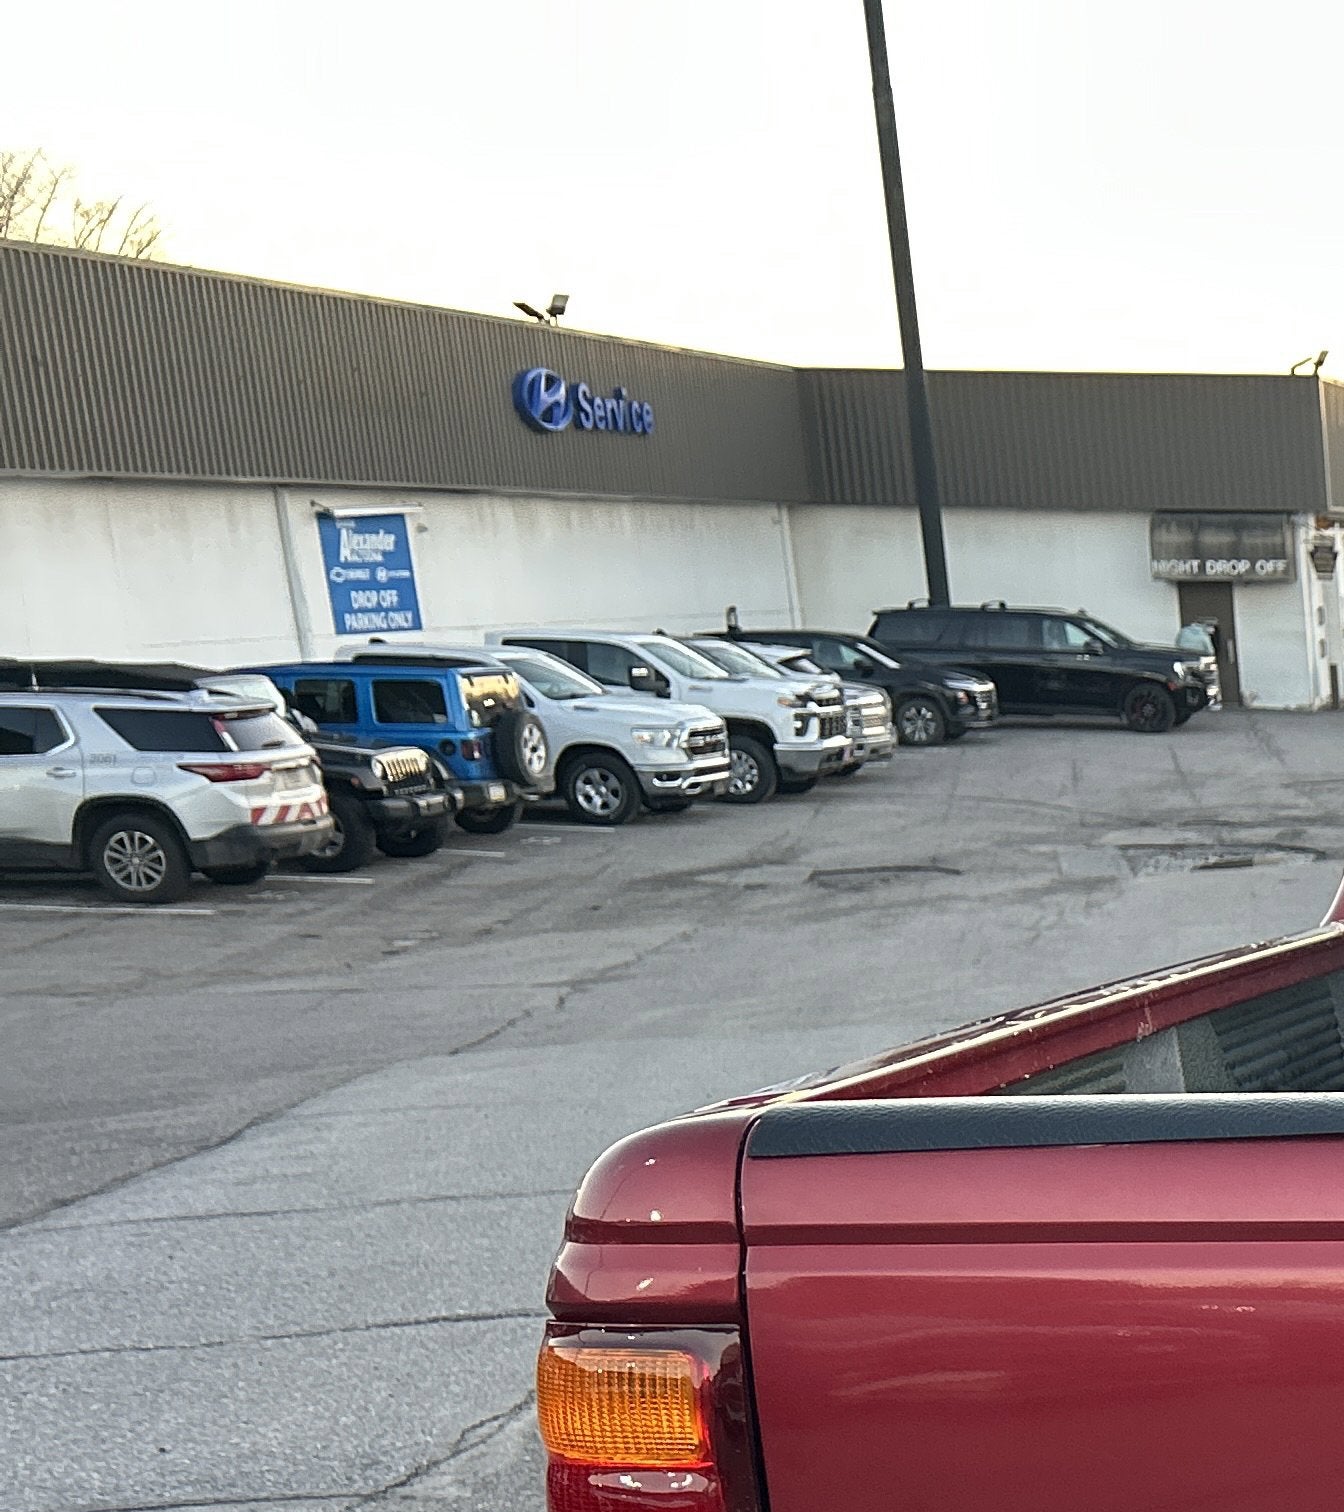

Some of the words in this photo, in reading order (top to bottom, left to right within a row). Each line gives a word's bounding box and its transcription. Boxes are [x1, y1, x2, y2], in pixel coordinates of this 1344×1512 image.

[574, 382, 656, 434] Service
[340, 528, 395, 563] Alexander
[1151, 559, 1201, 575] NIGHT
[1205, 559, 1250, 575] DROP
[1255, 559, 1288, 576] OFF
[350, 590, 378, 609] DROP
[379, 589, 399, 609] OFF
[343, 612, 388, 632] PARKING
[387, 610, 414, 630] ONLY
